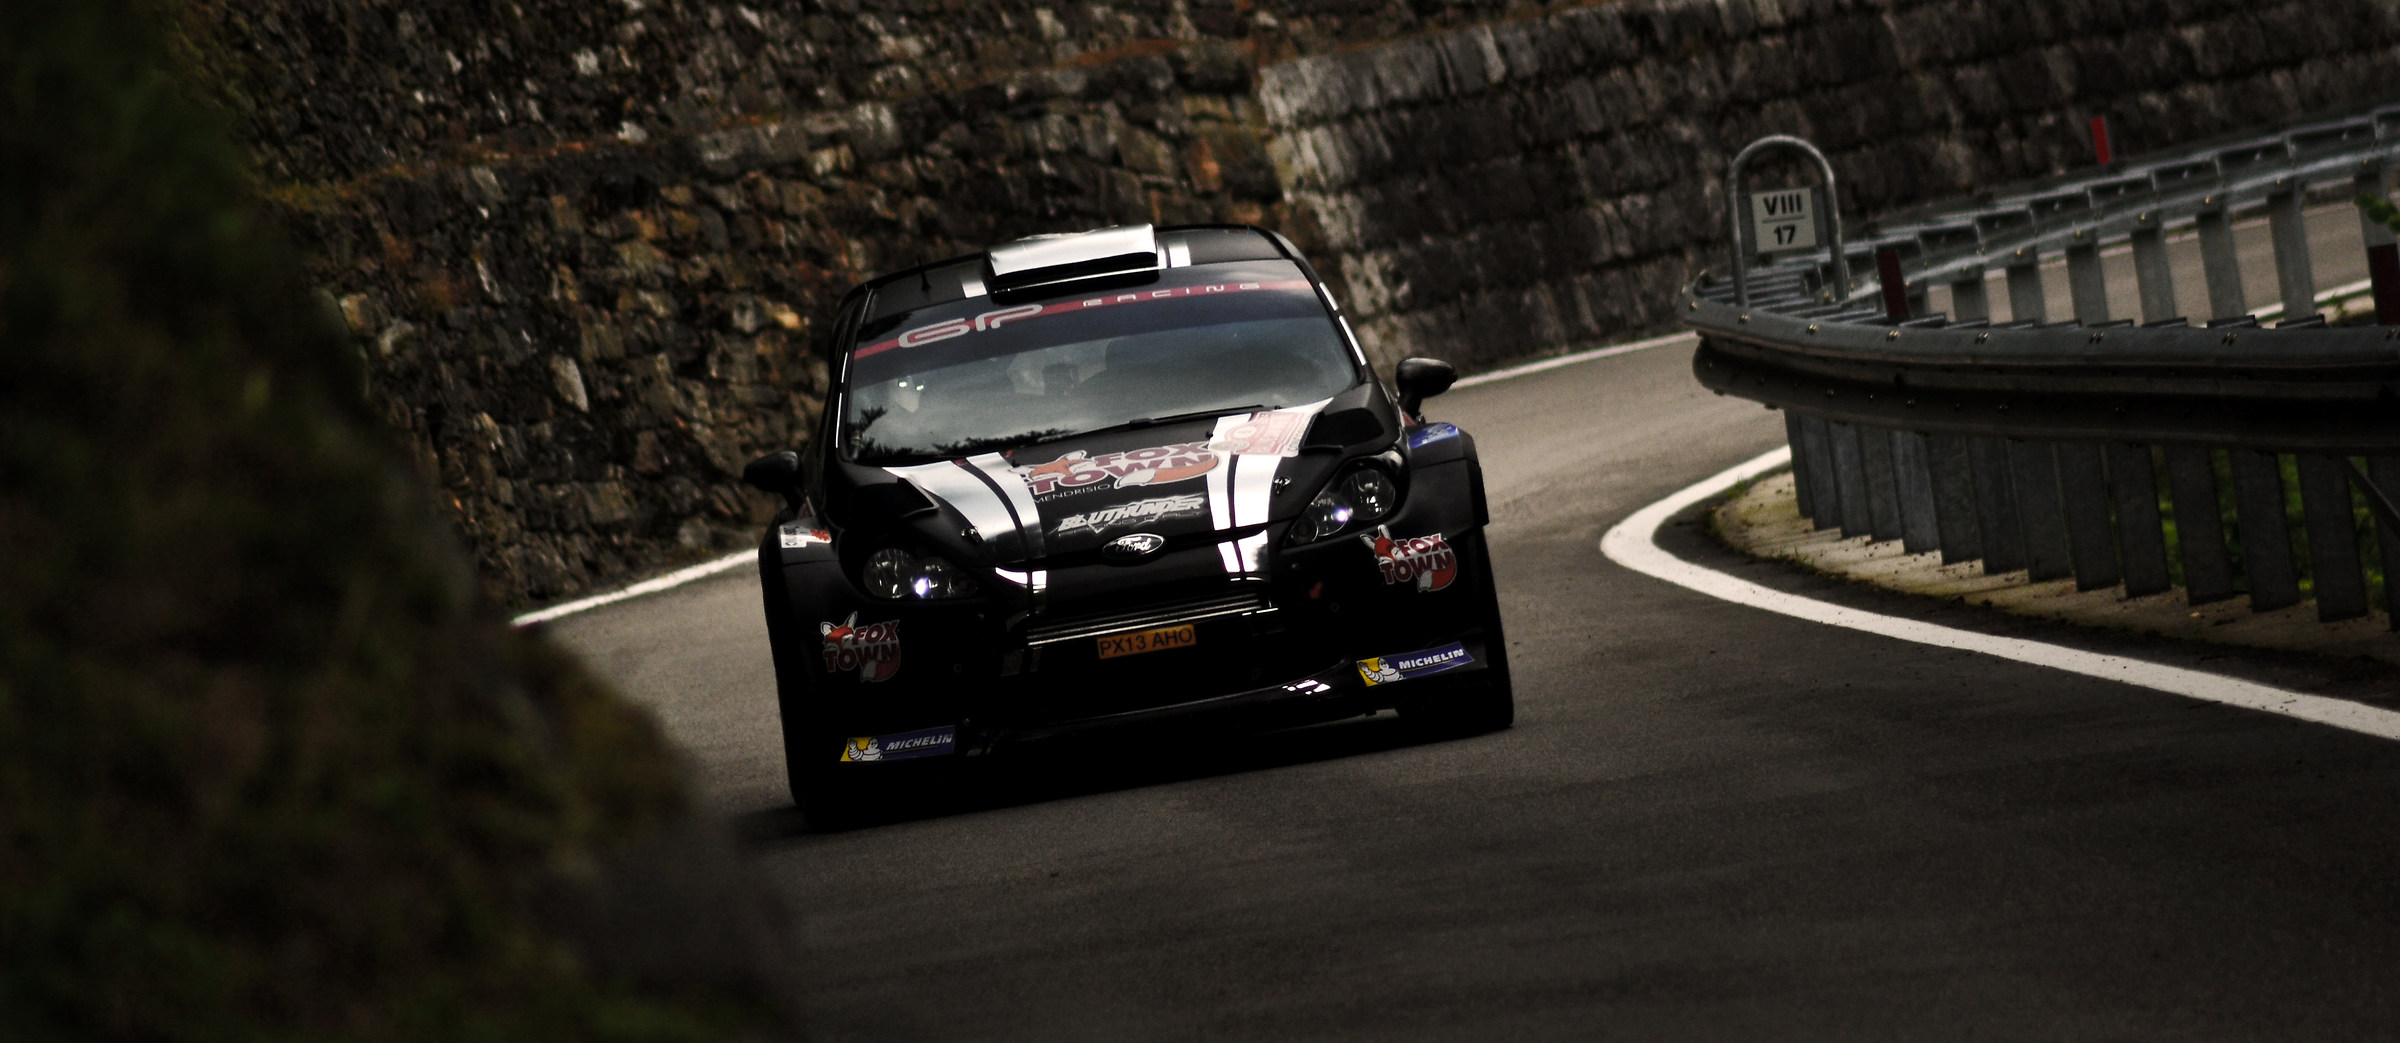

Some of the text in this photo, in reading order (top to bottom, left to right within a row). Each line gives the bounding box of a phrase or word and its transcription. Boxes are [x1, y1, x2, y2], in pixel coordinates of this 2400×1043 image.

[1763, 193, 1802, 215] VIII
[1774, 225, 1796, 245] 17
[898, 282, 1260, 348] GP RACING
[1091, 441, 1210, 469] FOX
[1026, 453, 1215, 495] TOWN
[1034, 482, 1110, 504] MENDRISIO
[1114, 536, 1152, 552] Ford
[1395, 534, 1449, 557] FOX
[1380, 551, 1452, 584] TOWN
[852, 620, 899, 645] FOX
[1100, 628, 1193, 656] PX13 AHO
[823, 643, 898, 673] TOWN
[1399, 648, 1465, 670] MICHELIN
[886, 733, 953, 751] MICHELIN
